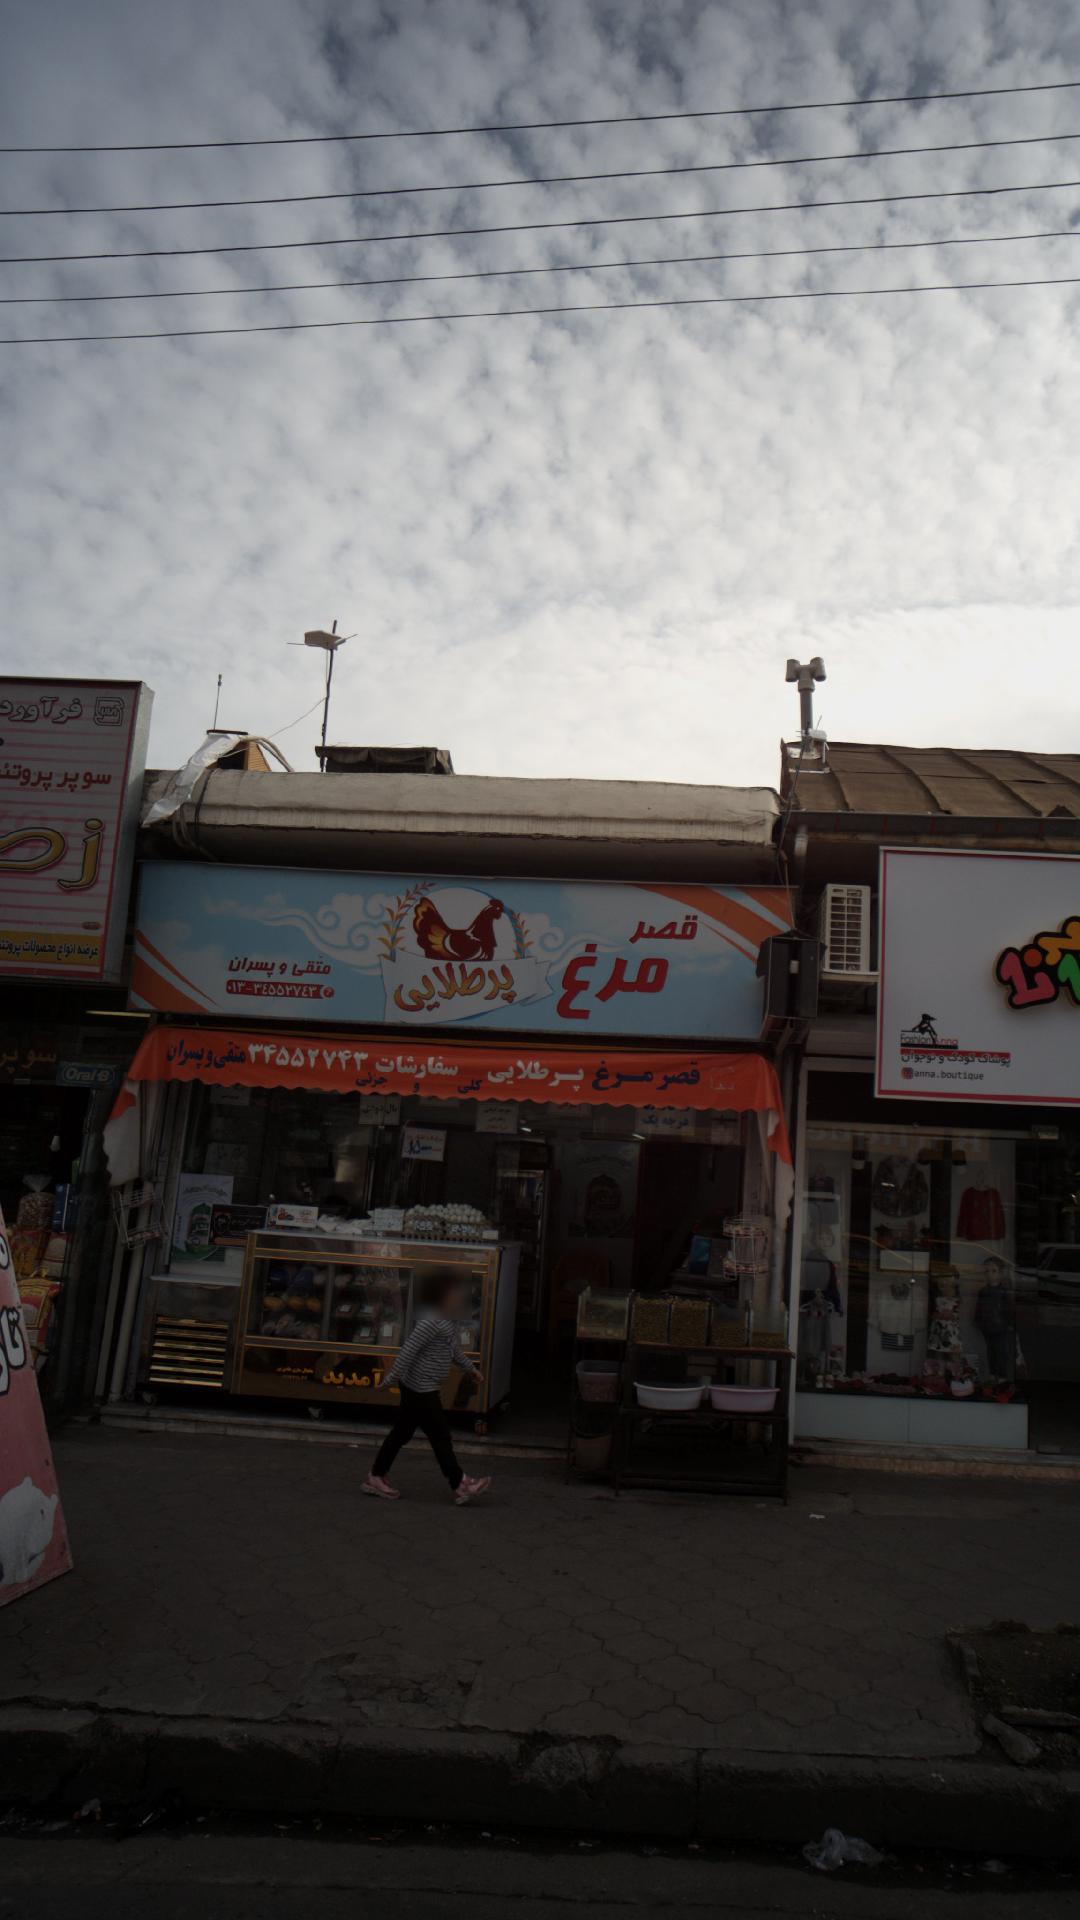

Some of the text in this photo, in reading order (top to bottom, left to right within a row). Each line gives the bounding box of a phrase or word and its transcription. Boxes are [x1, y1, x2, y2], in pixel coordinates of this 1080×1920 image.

[0, 763, 112, 792] سوپر پروتئ
[629, 914, 698, 944] قصر
[23, 938, 57, 956] محصولات
[56, 943, 76, 961] انواع
[77, 944, 98, 958] عرضه
[228, 956, 331, 978] متقی و پسران
[393, 962, 515, 1013] پرطلایی
[557, 943, 669, 1019] مرغ
[167, 1039, 204, 1069] پسران
[205, 1050, 213, 1068] و
[214, 1041, 246, 1068] متقی
[248, 1043, 368, 1072] ۳۴۵۵۲۷۴۳
[375, 1050, 459, 1079] سفارشات
[901, 1052, 1011, 1067] پوشاک کودک و نوجوان
[414, 1082, 421, 1093] و
[458, 1079, 483, 1094] کلی
[592, 1060, 654, 1091] مرغ
[657, 1060, 700, 1090] قصر
[913, 1070, 984, 1081] anna.boutique
